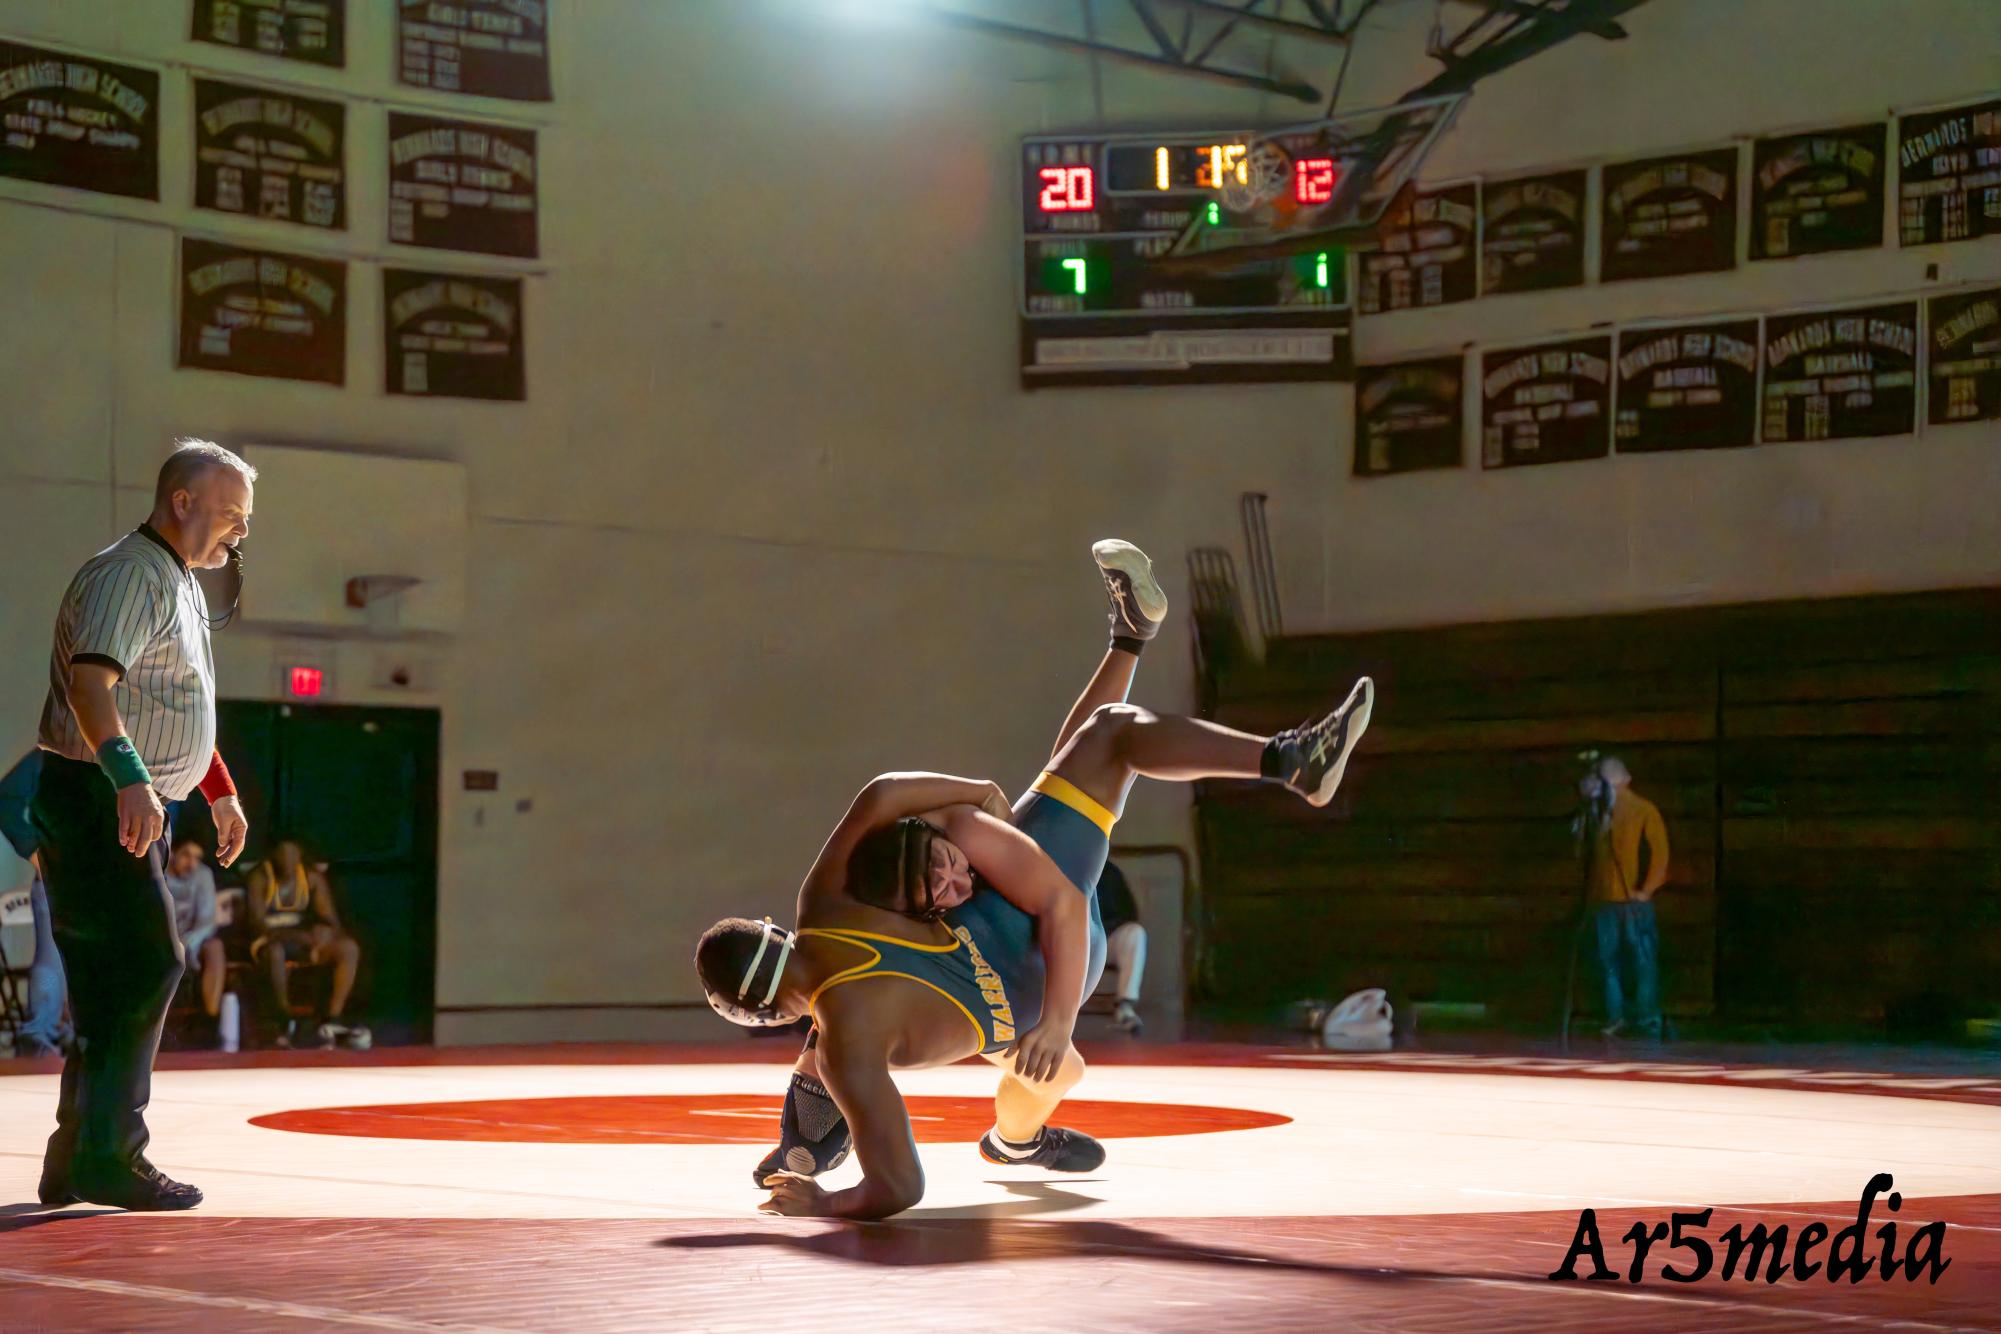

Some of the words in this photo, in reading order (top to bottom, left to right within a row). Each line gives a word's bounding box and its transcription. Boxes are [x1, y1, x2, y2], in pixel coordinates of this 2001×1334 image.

[1040, 167, 1093, 211] 20
[1296, 160, 1333, 203] 12
[1062, 258, 1086, 294] 7
